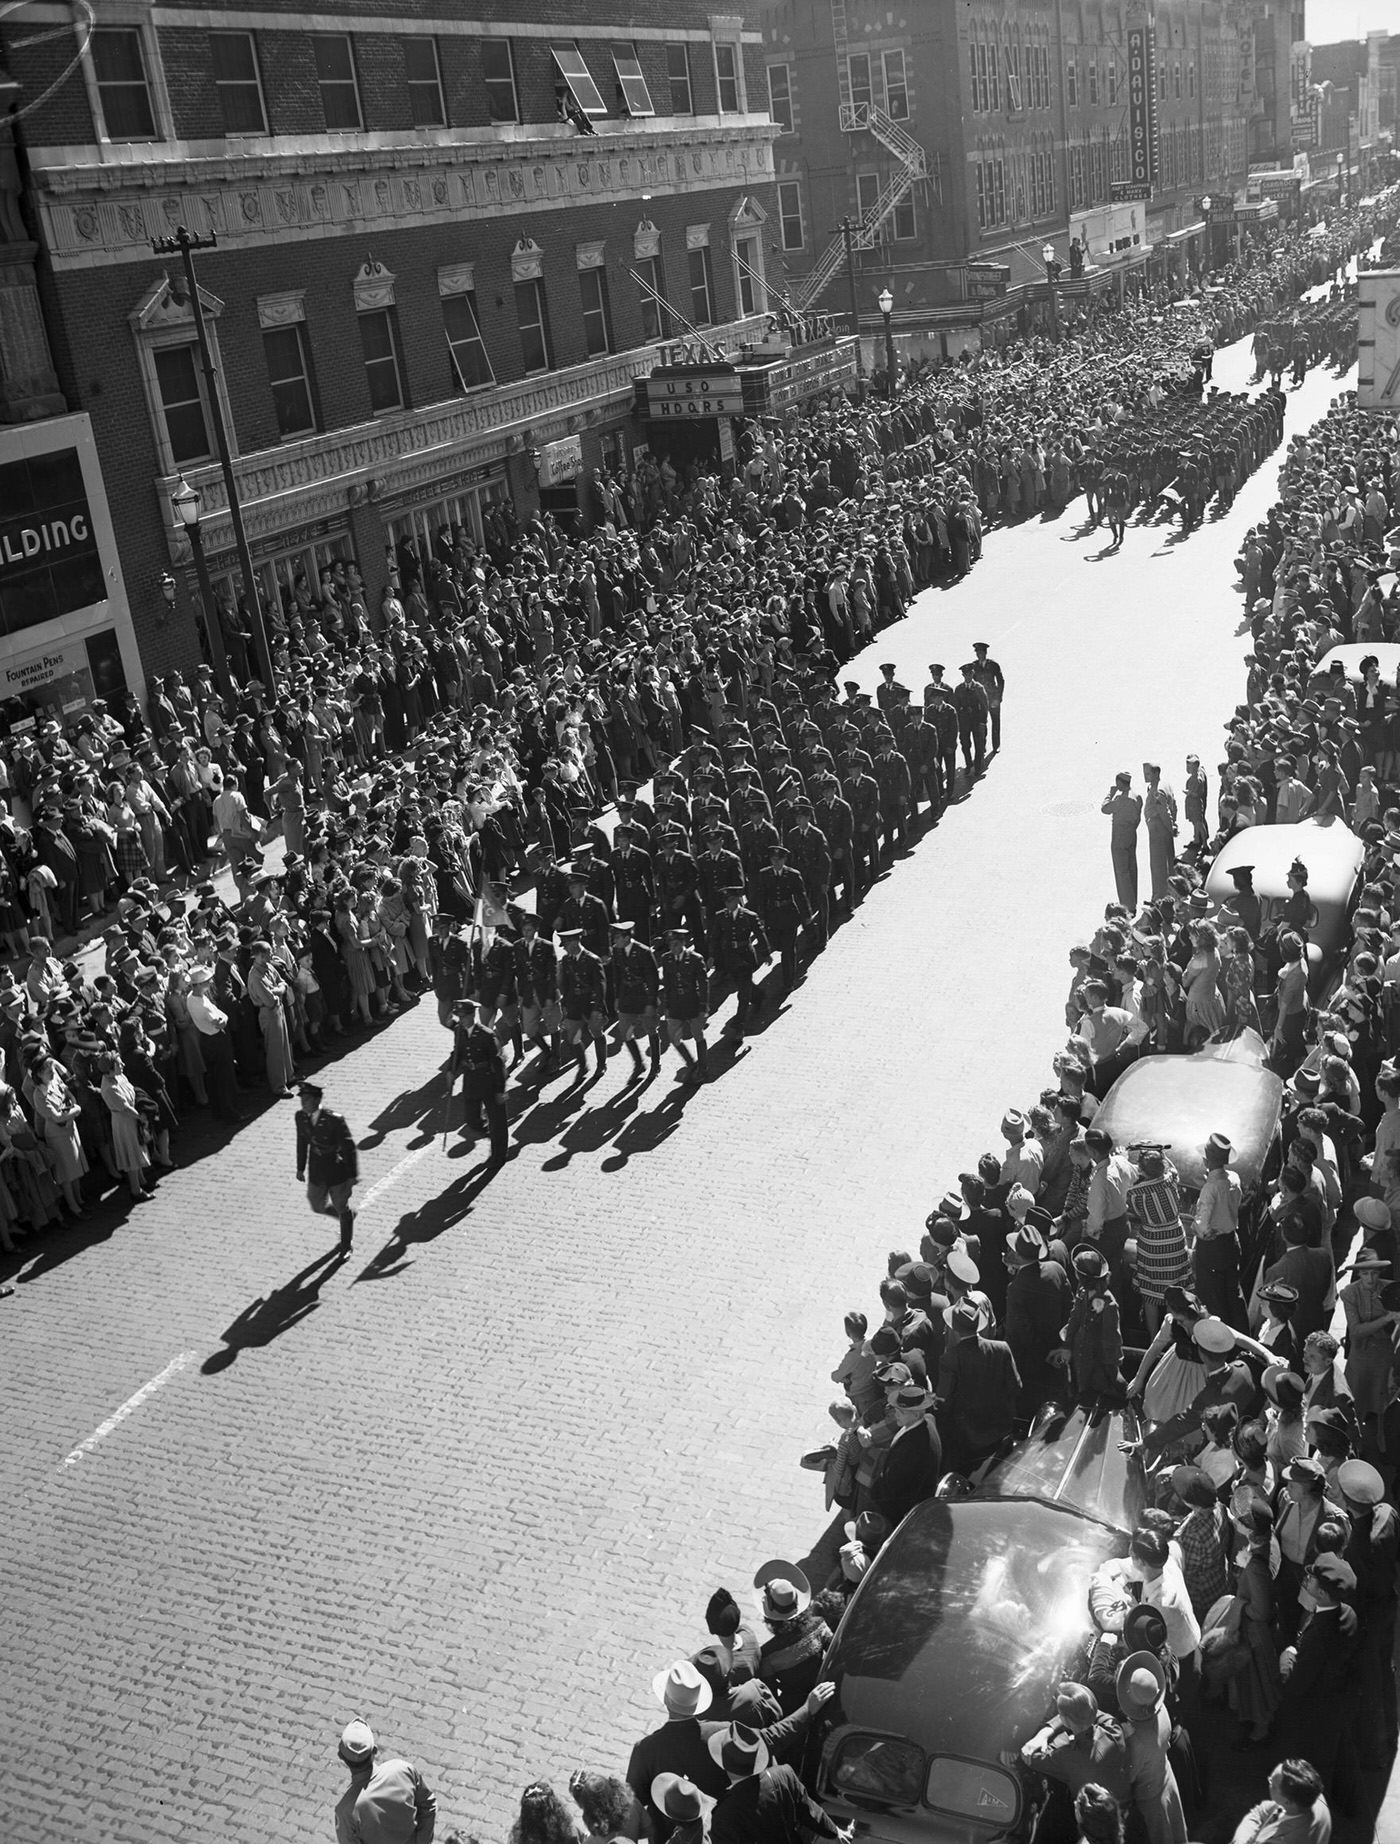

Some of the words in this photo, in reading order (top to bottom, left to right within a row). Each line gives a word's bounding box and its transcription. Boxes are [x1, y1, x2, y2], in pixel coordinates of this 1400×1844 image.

[1240, 27, 1252, 95] HOTEL
[656, 341, 726, 366] TEXAS
[666, 381, 709, 394] USO
[661, 400, 725, 415] HDQRS
[6, 663, 43, 682] FOUNTAIN
[43, 655, 64, 669] PENS
[21, 669, 54, 687] REPAIRED
